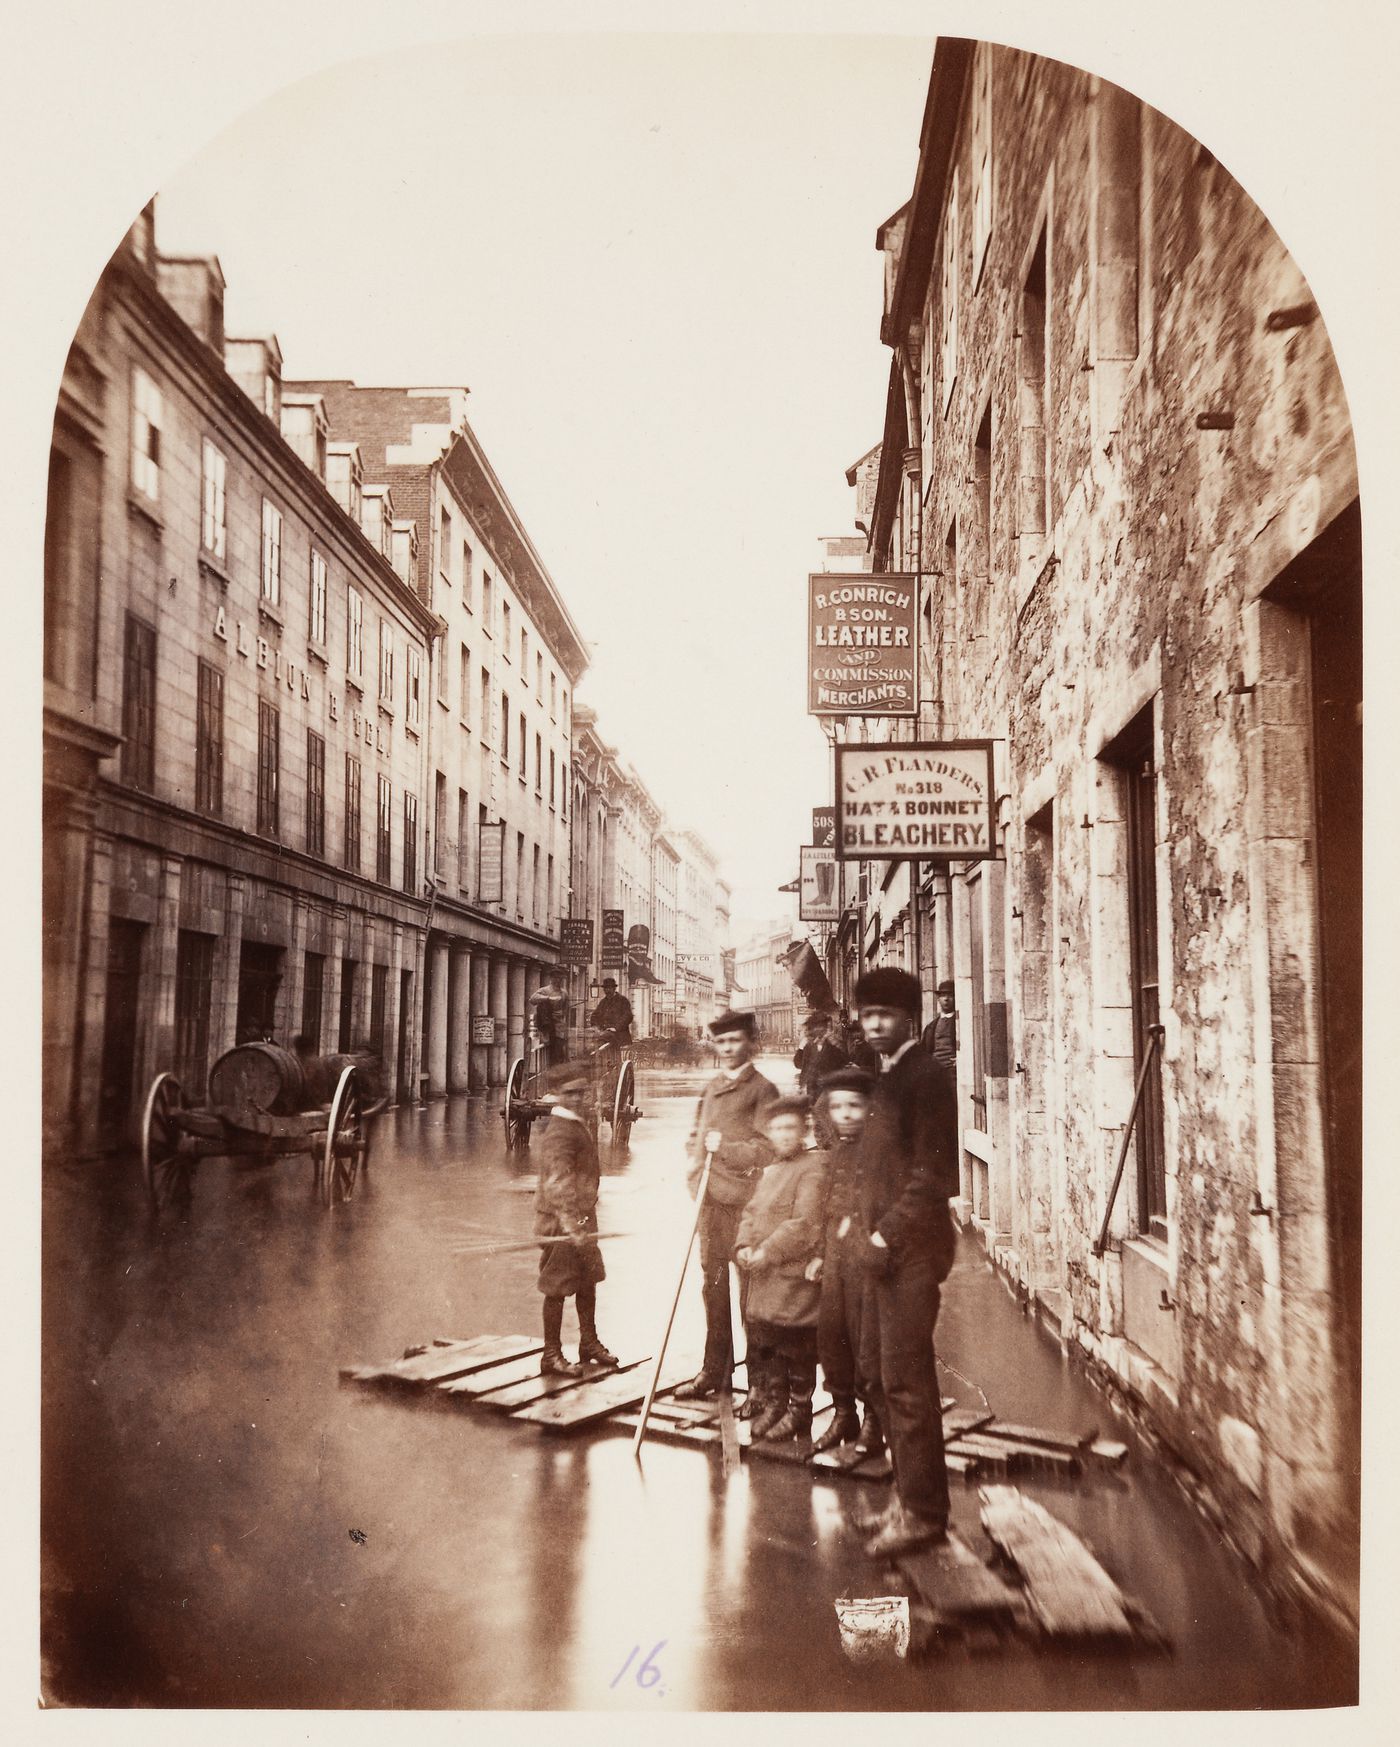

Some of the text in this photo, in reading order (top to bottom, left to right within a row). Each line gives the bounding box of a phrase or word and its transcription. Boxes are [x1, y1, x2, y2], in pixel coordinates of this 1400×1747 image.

[835, 608, 893, 622] & SON.
[815, 625, 911, 647] LEATHER
[214, 606, 311, 702] ALBION
[838, 648, 874, 665] AND
[813, 668, 912, 682] COMMISSION
[817, 682, 911, 706] MERCHANTS.
[846, 800, 886, 816] HAT
[905, 800, 982, 815] BONNET
[843, 823, 986, 846] BLEACHERY.
